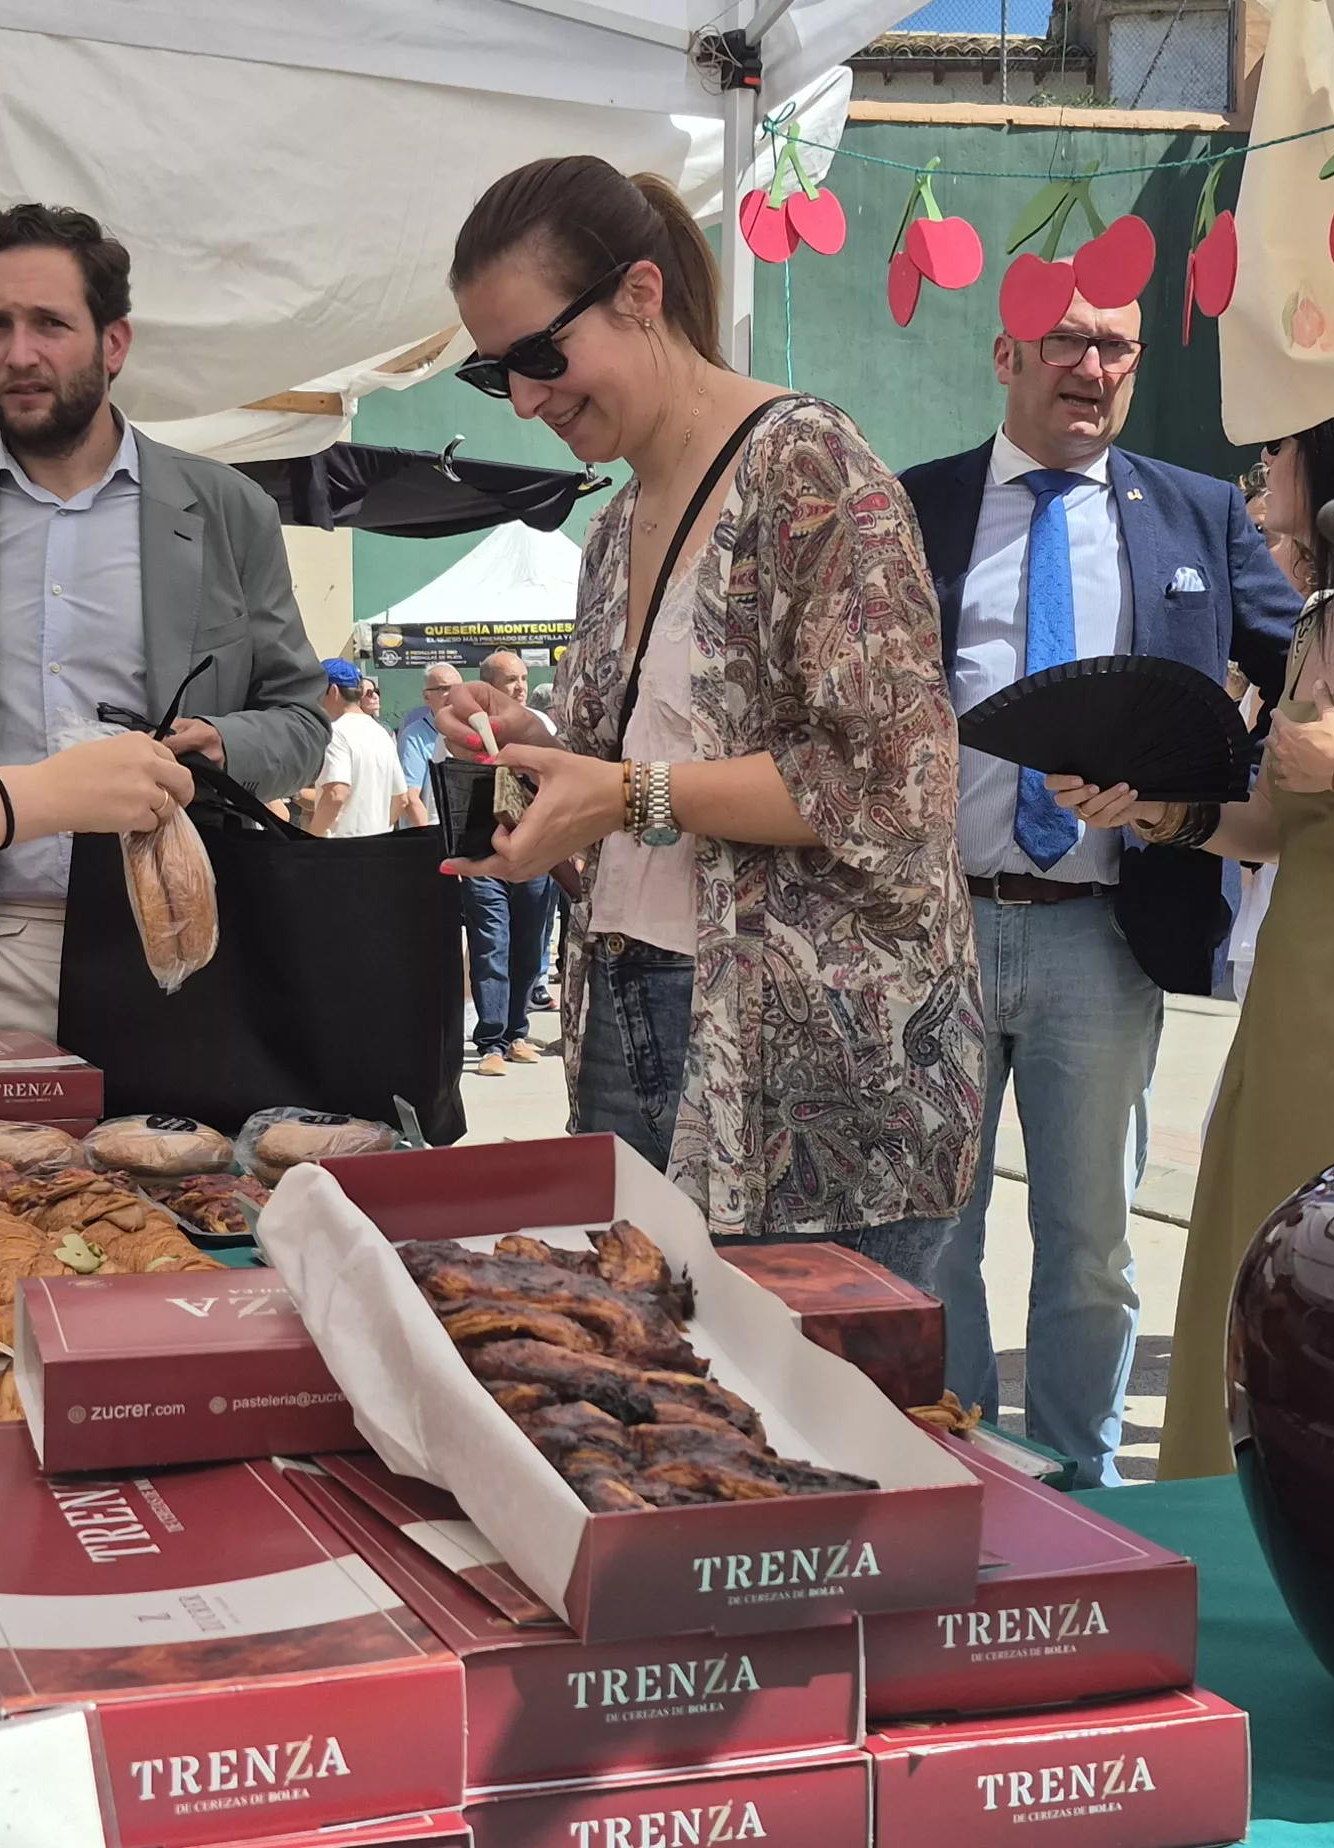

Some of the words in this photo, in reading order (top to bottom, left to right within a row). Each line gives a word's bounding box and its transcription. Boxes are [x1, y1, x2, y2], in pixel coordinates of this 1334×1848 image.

[424, 624, 490, 636] QUESERÍA
[91, 1401, 185, 1421] zucrer.com
[233, 1391, 349, 1411] pasteleria@zucre
[49, 1481, 161, 1563] TREN
[693, 1539, 881, 1592] TRENZA
[728, 1596, 743, 1606] DE
[744, 1591, 791, 1604] CEREZAS
[792, 1589, 806, 1599] DE
[808, 1585, 845, 1597] BOLEA
[937, 1598, 1110, 1648] TRENZA
[971, 1652, 984, 1662] DE
[986, 1648, 1029, 1661] CEREZAS
[1030, 1646, 1042, 1657] DE
[1044, 1644, 1077, 1655] BOLEA
[568, 1653, 761, 1709] TRENZA
[606, 1713, 620, 1723] DE
[622, 1709, 670, 1721] CEREZAS
[671, 1706, 685, 1716] DE
[687, 1702, 725, 1714] BOLEA
[130, 1734, 351, 1801] TRENZA
[977, 1753, 1157, 1811] TRENZA
[175, 1803, 192, 1815] DE
[194, 1796, 247, 1813] CEREZAS
[250, 1793, 265, 1805] DE
[268, 1788, 311, 1802] BOLEA
[1013, 1814, 1027, 1824] DE
[1028, 1808, 1072, 1822] CEREZAS
[1073, 1806, 1087, 1816] DE
[1089, 1802, 1123, 1814] BOLEA
[570, 1798, 767, 1848] TRENZA
